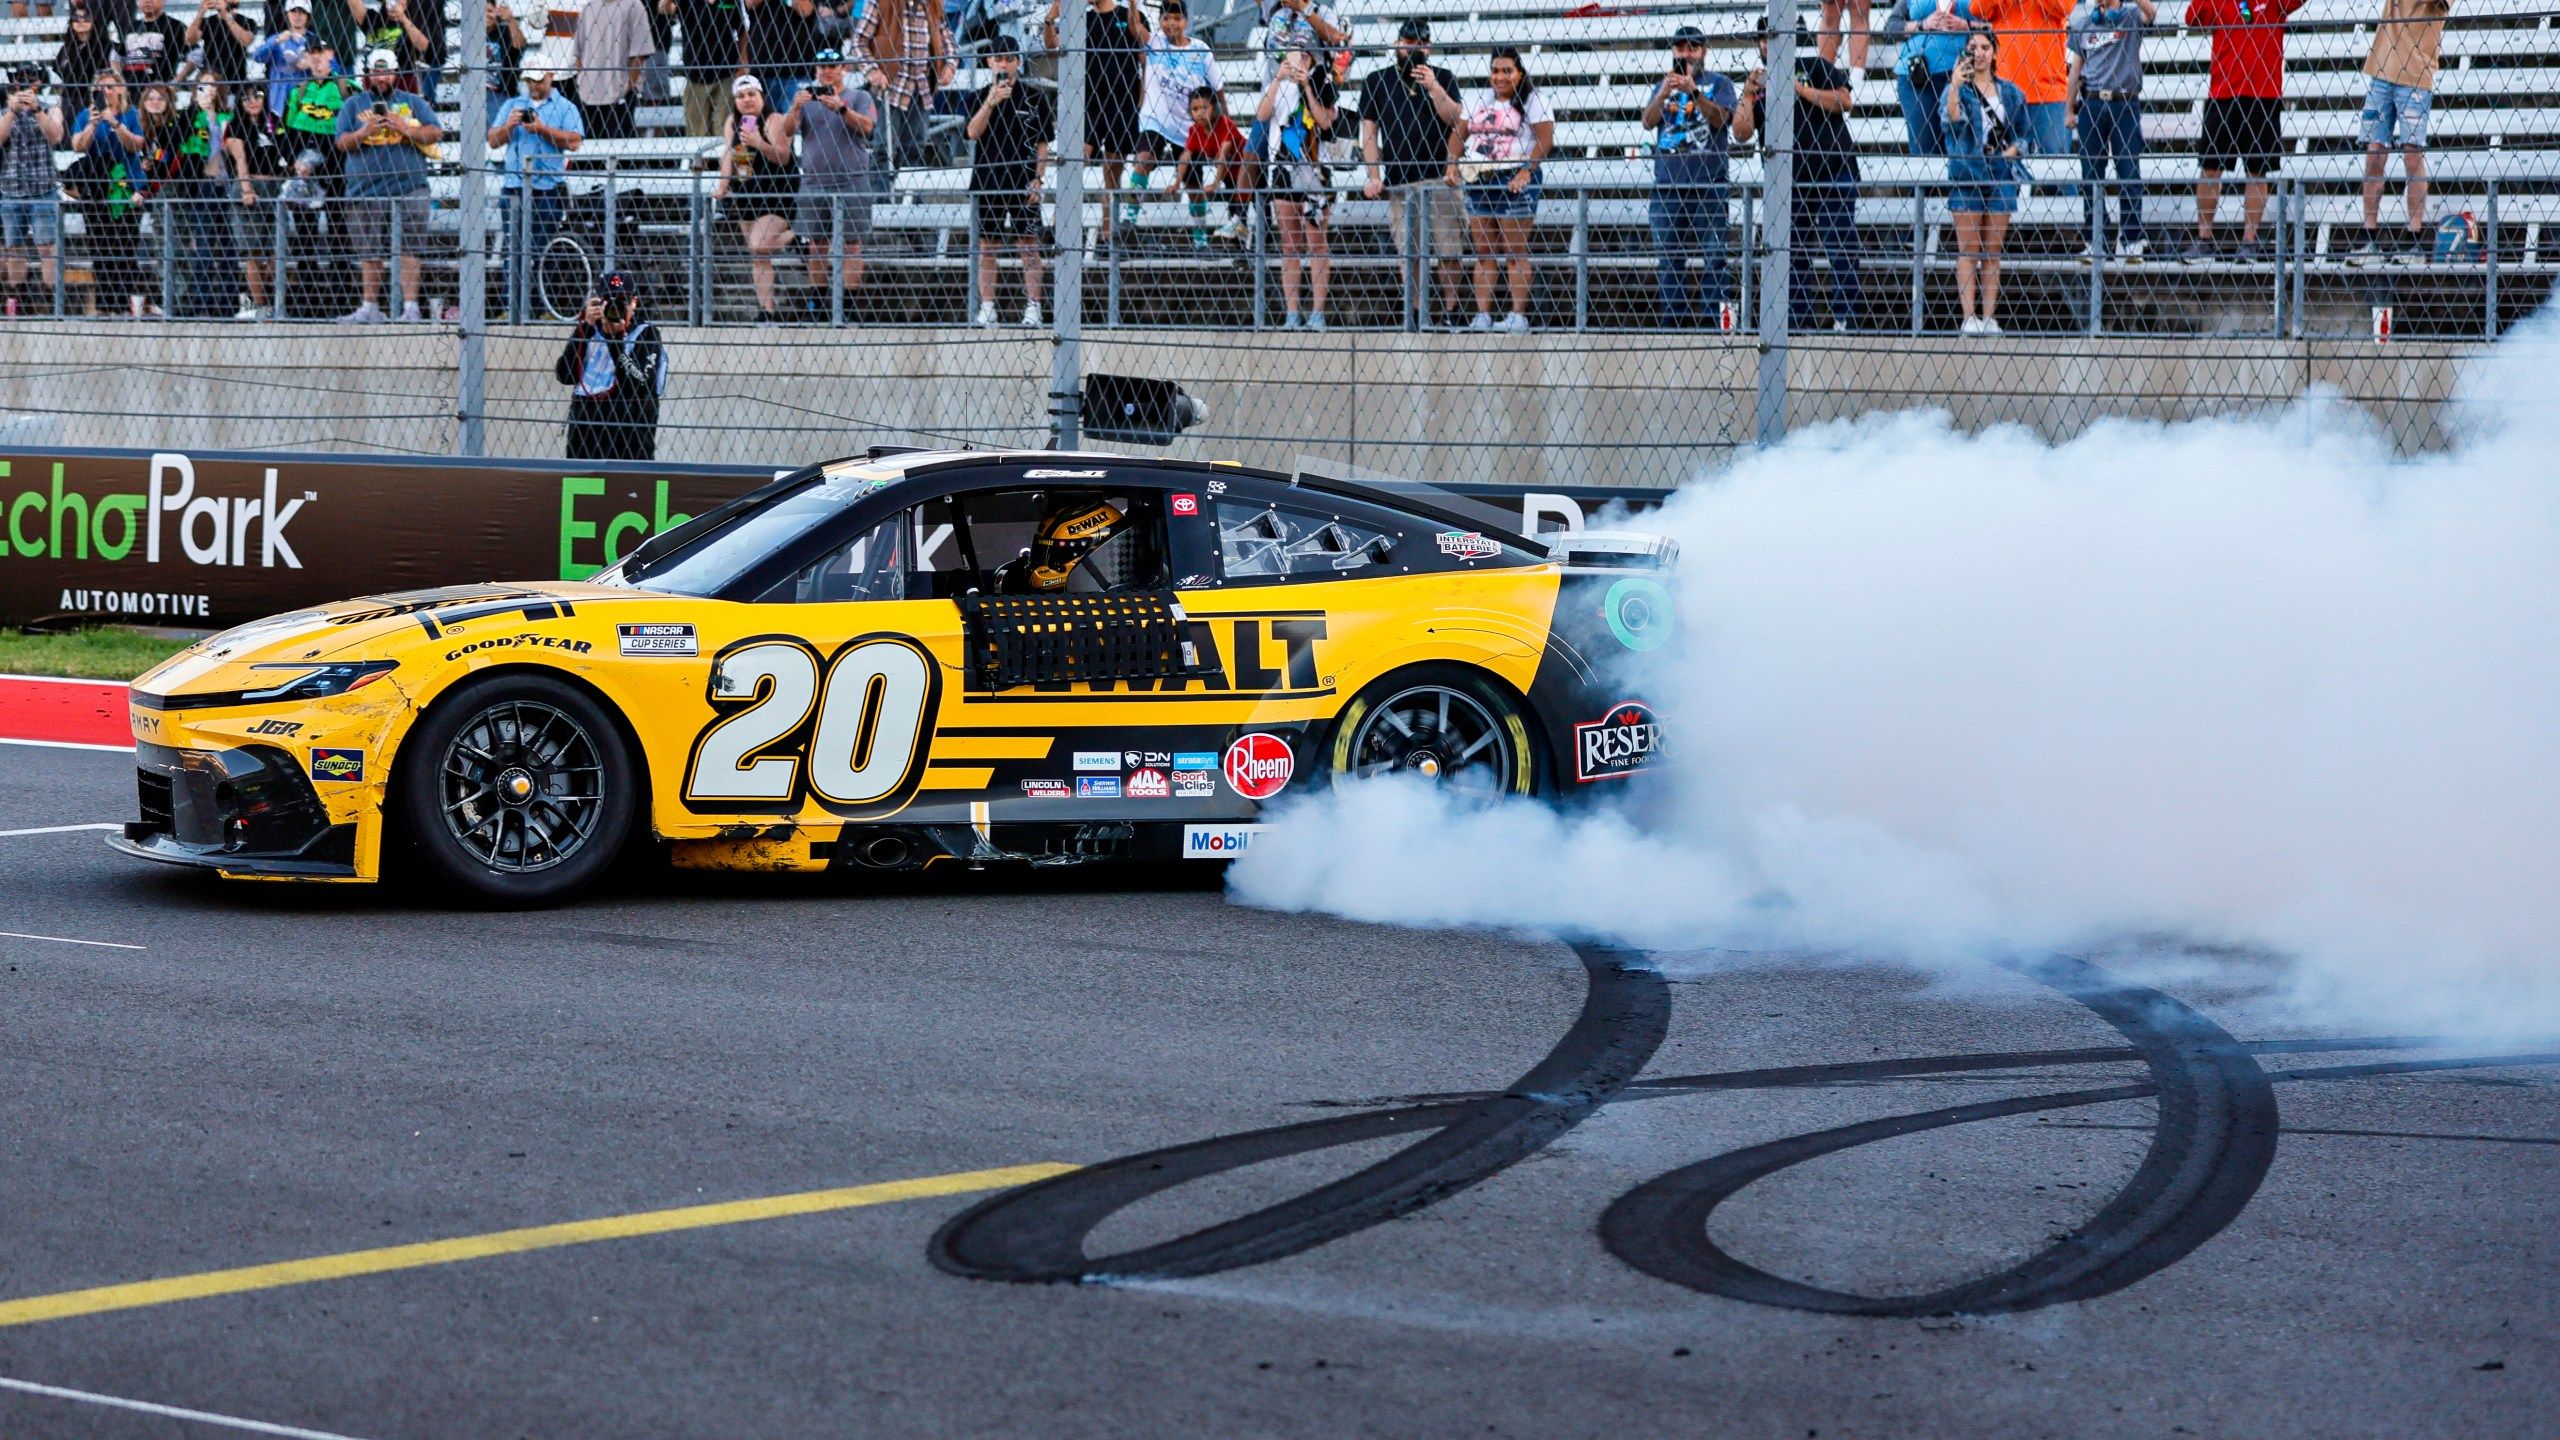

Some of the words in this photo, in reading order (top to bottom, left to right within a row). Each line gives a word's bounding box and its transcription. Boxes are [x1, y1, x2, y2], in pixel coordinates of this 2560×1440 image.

[0, 453, 304, 569] choPark
[1067, 511, 1109, 535] DEWALT
[1439, 535, 1497, 547] INTERSTATE
[1444, 543, 1498, 552] BATTERIES
[60, 588, 210, 616] AUTOMOTIVE
[642, 626, 684, 635] NASCAR
[445, 636, 593, 661] GOODYEAR
[631, 639, 650, 649] CUP
[652, 639, 686, 649] SERIES
[246, 719, 303, 736] JGR
[681, 632, 943, 820] 20
[1078, 757, 1115, 765] SIEMENS
[1144, 752, 1171, 762] DN
[1177, 757, 1214, 765] stratasys
[1233, 736, 1289, 788] Rheem
[1610, 758, 1629, 767] FINE
[314, 758, 361, 771] SUNOCO
[1128, 769, 1167, 788] MAC
[1172, 771, 1207, 782] Sport
[1023, 780, 1062, 789] LINCOLN
[1184, 780, 1214, 791] Clips
[1031, 789, 1066, 797] WELDERS
[1129, 788, 1167, 796] TOOLS
[1191, 831, 1248, 851] Mobil
